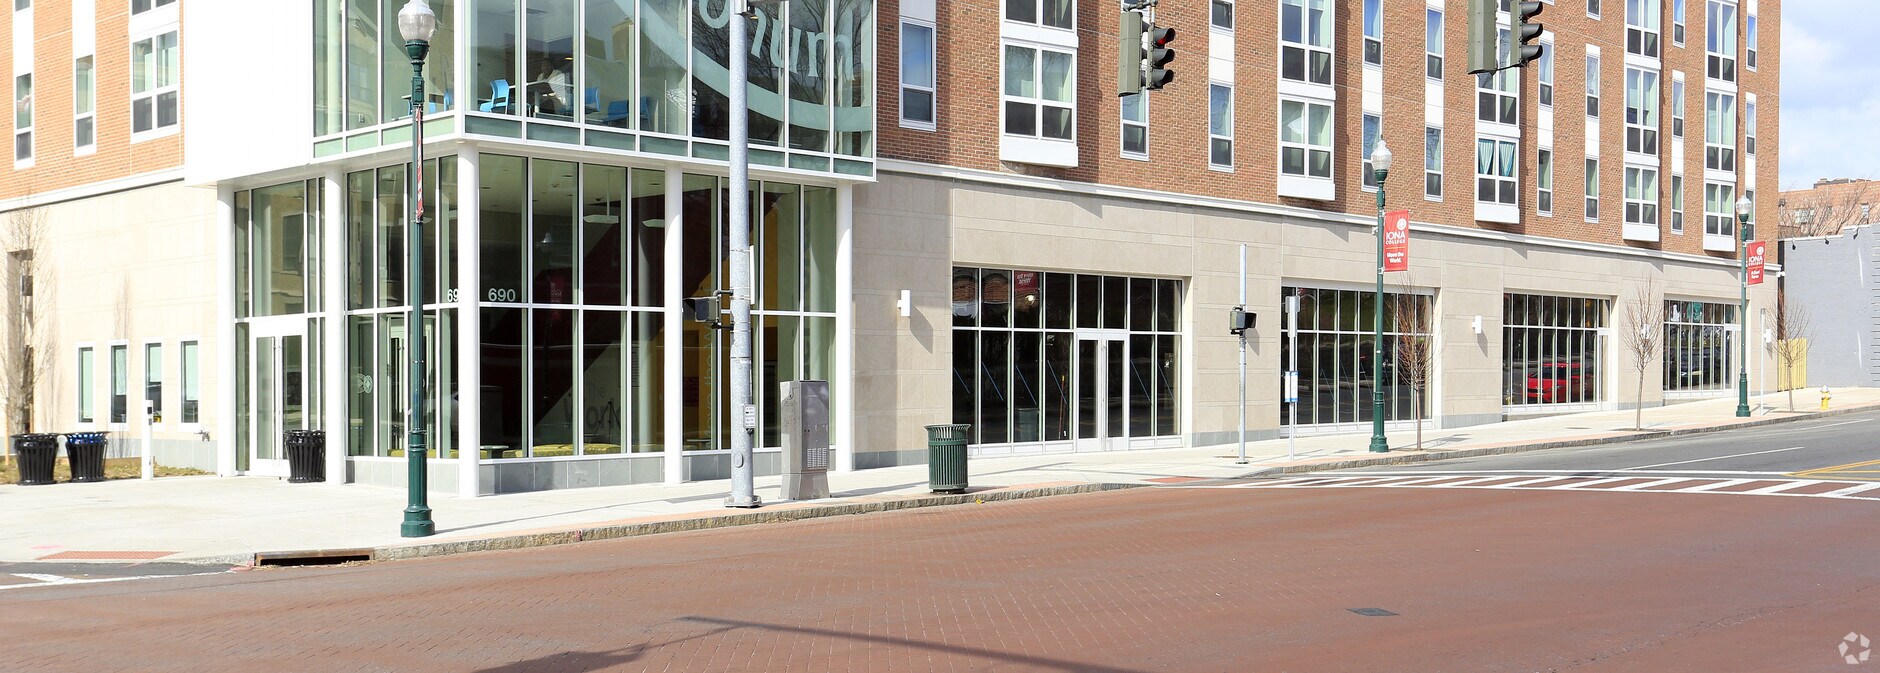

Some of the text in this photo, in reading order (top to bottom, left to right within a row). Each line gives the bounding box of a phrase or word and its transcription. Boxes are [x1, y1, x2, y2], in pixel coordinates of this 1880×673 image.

[1386, 231, 1405, 240] IONA
[447, 288, 459, 303] 69
[488, 288, 516, 302] 690
